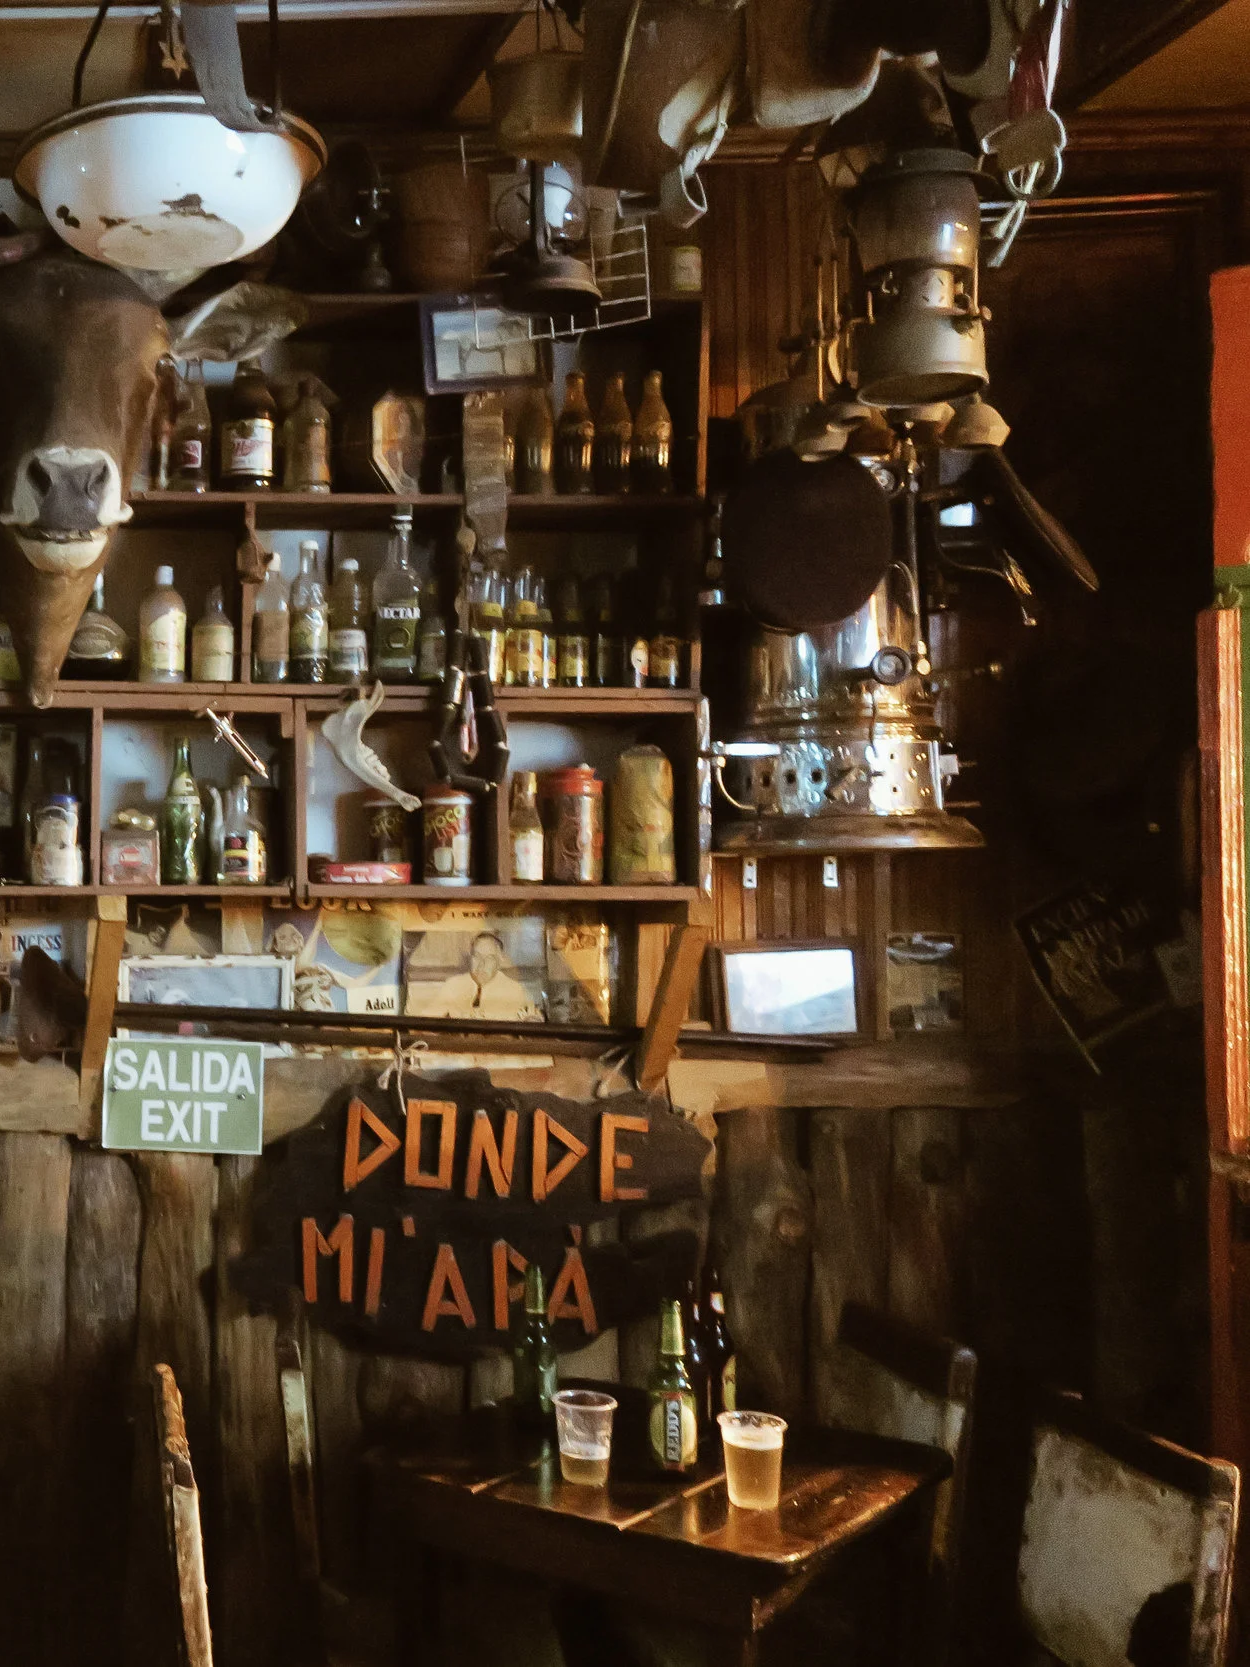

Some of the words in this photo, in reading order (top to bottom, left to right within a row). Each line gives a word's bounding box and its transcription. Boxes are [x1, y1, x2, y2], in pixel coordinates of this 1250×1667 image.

[112, 1048, 256, 1095] SALIDA
[140, 1099, 228, 1144] EXIT
[343, 1096, 649, 1204] DONDE
